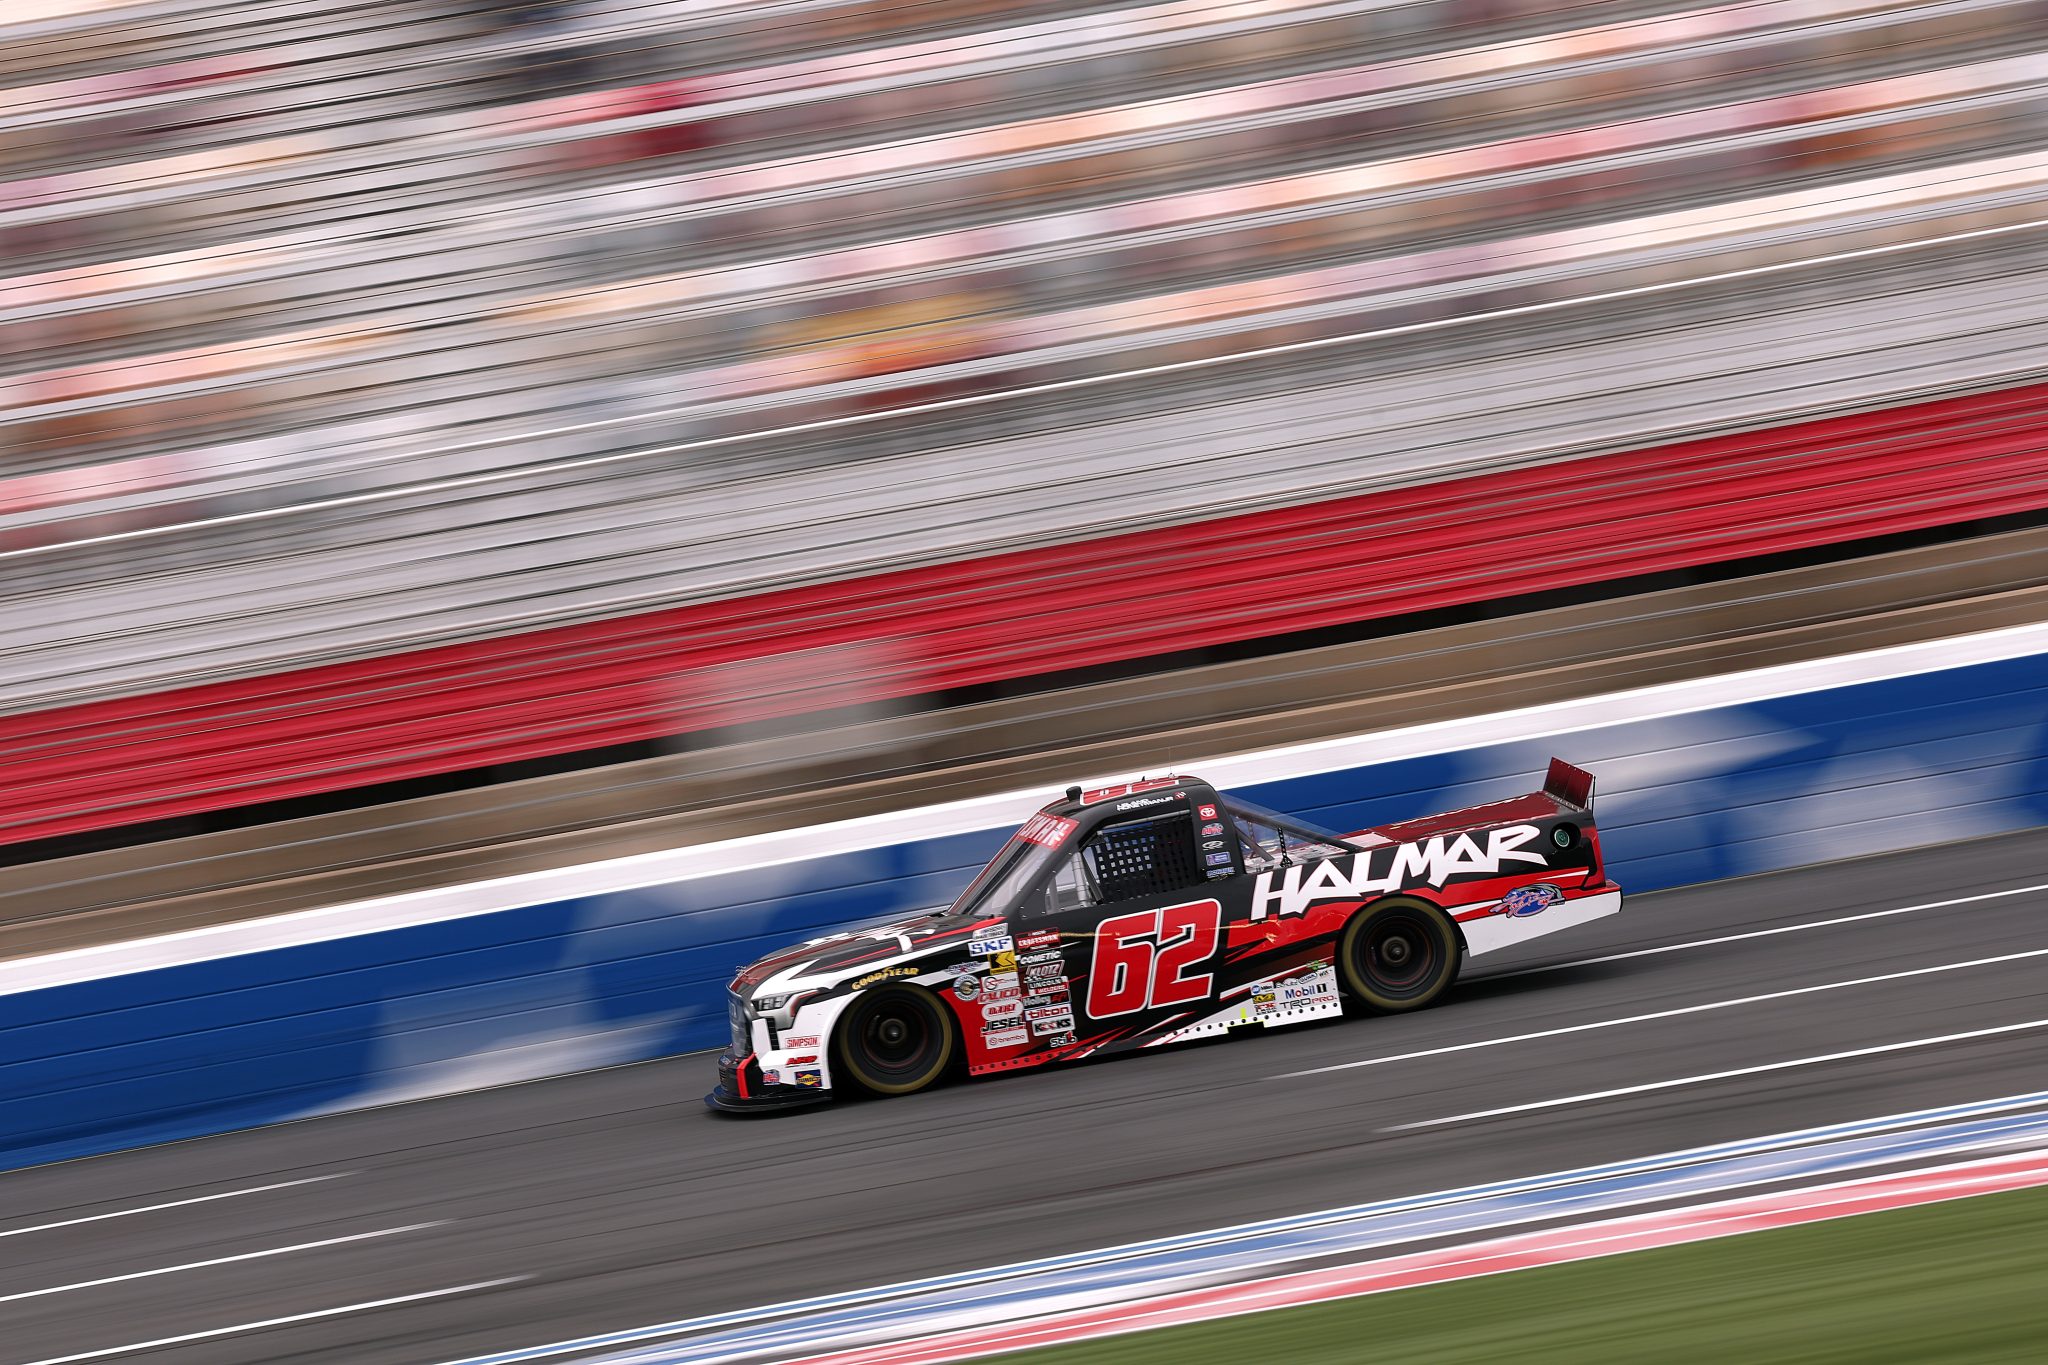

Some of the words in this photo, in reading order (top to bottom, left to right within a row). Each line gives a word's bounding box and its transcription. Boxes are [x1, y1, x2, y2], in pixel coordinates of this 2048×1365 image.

[1250, 824, 1549, 921] HALMAR
[971, 939, 1009, 954] SKF
[1020, 951, 1061, 964] COMETIC
[1086, 898, 1222, 1020] 62
[1028, 963, 1060, 977] KLOTZ
[851, 966, 920, 991] GOODYEAR
[1285, 984, 1316, 999] Mobil
[1316, 983, 1327, 994] 1
[1022, 995, 1051, 1006] Holley
[1280, 998, 1311, 1009] TRD
[1028, 1006, 1069, 1019] tilton
[982, 1017, 1024, 1032] JESEL
[787, 1037, 818, 1048] SIMPSON
